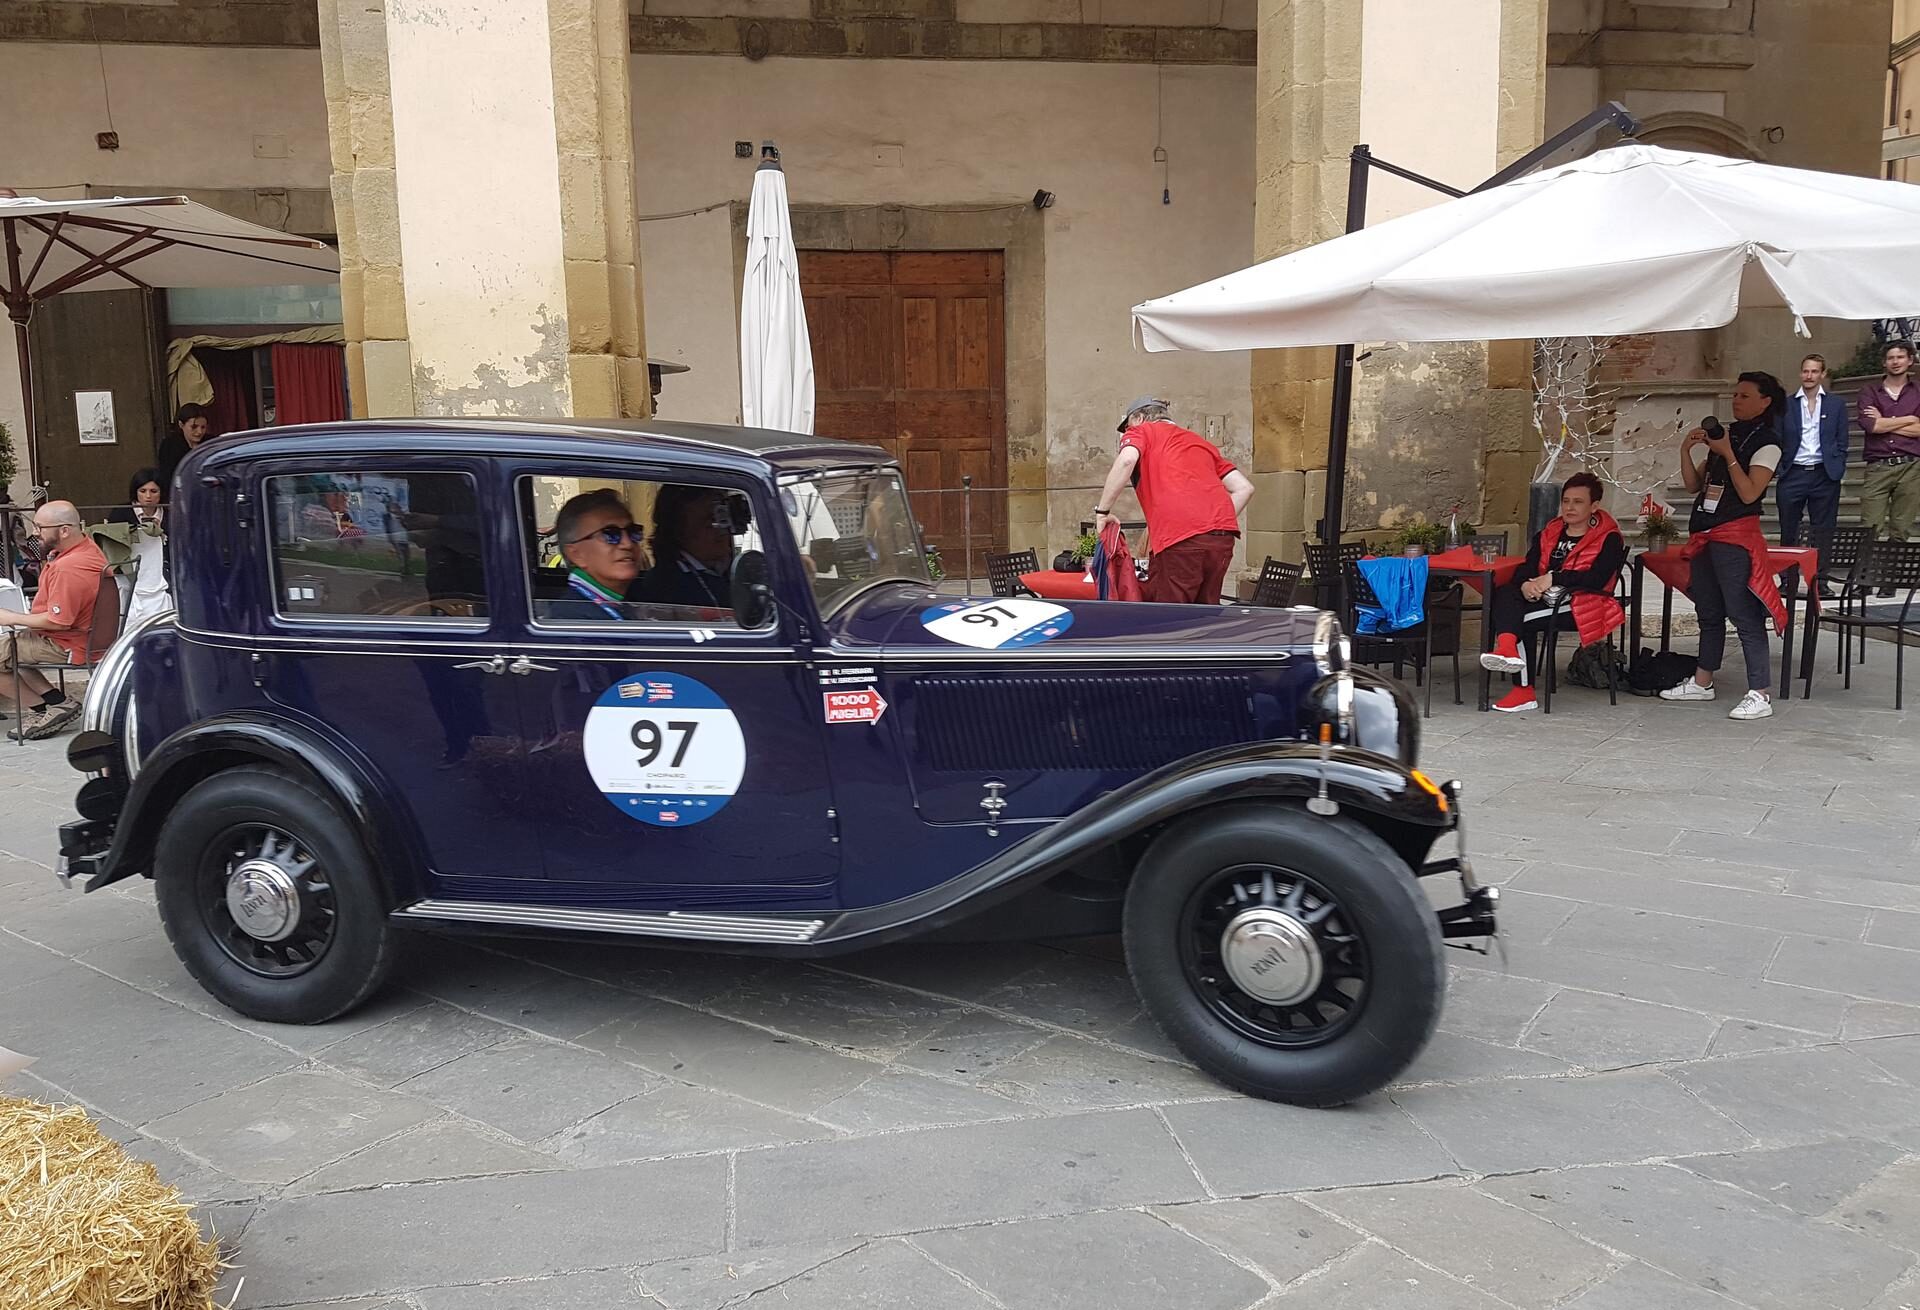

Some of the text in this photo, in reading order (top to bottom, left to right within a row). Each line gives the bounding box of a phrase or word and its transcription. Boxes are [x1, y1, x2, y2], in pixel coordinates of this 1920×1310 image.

[961, 605, 1018, 628] 97
[830, 694, 870, 706] 1000
[630, 719, 700, 768] 97
